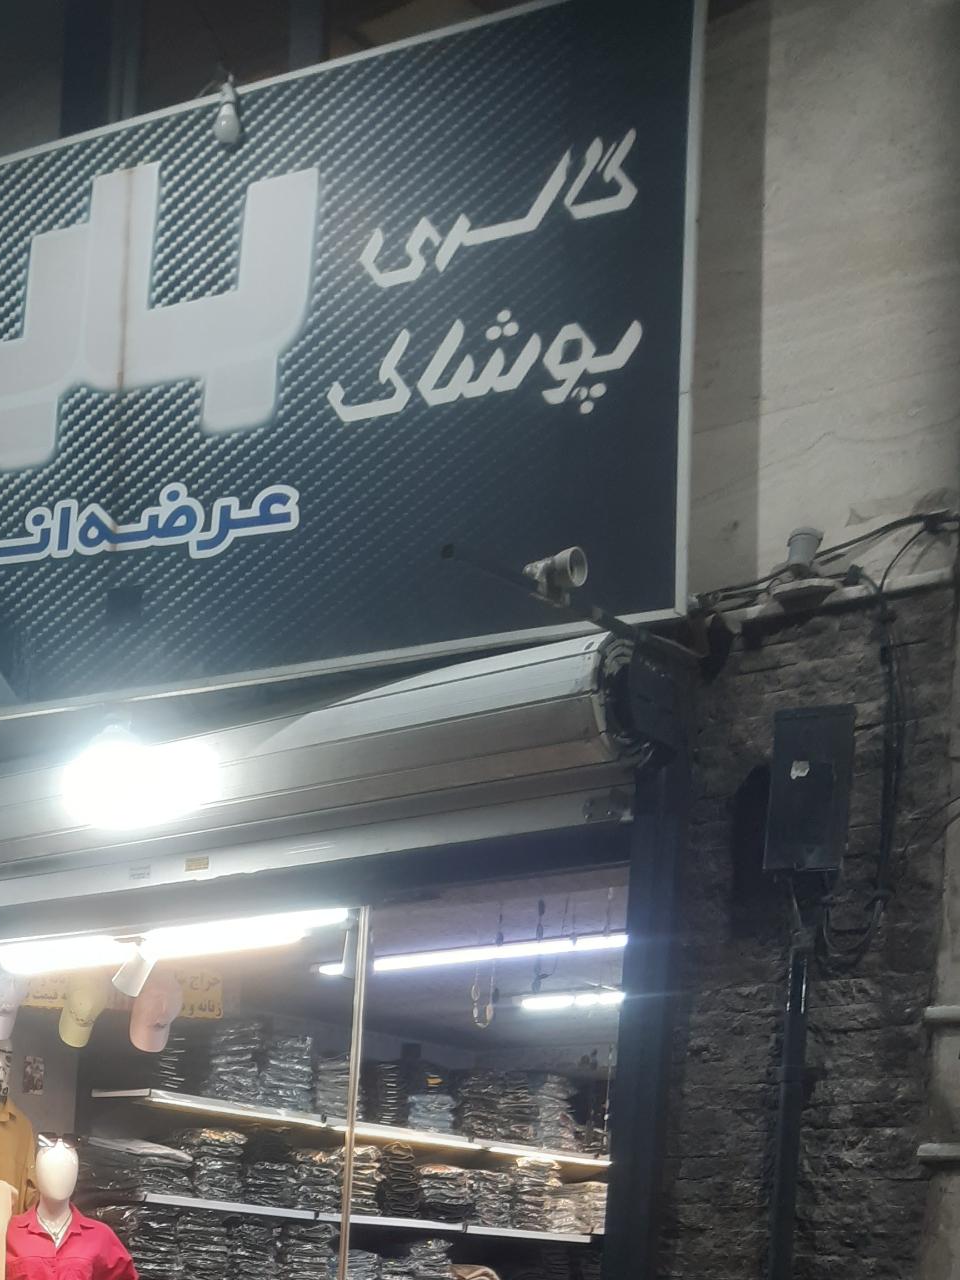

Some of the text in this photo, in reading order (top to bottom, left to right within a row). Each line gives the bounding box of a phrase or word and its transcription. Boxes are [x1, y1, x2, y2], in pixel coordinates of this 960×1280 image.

[359, 128, 638, 288] گالری
[326, 308, 643, 416] پوشاک
[77, 482, 299, 559] عرضه
